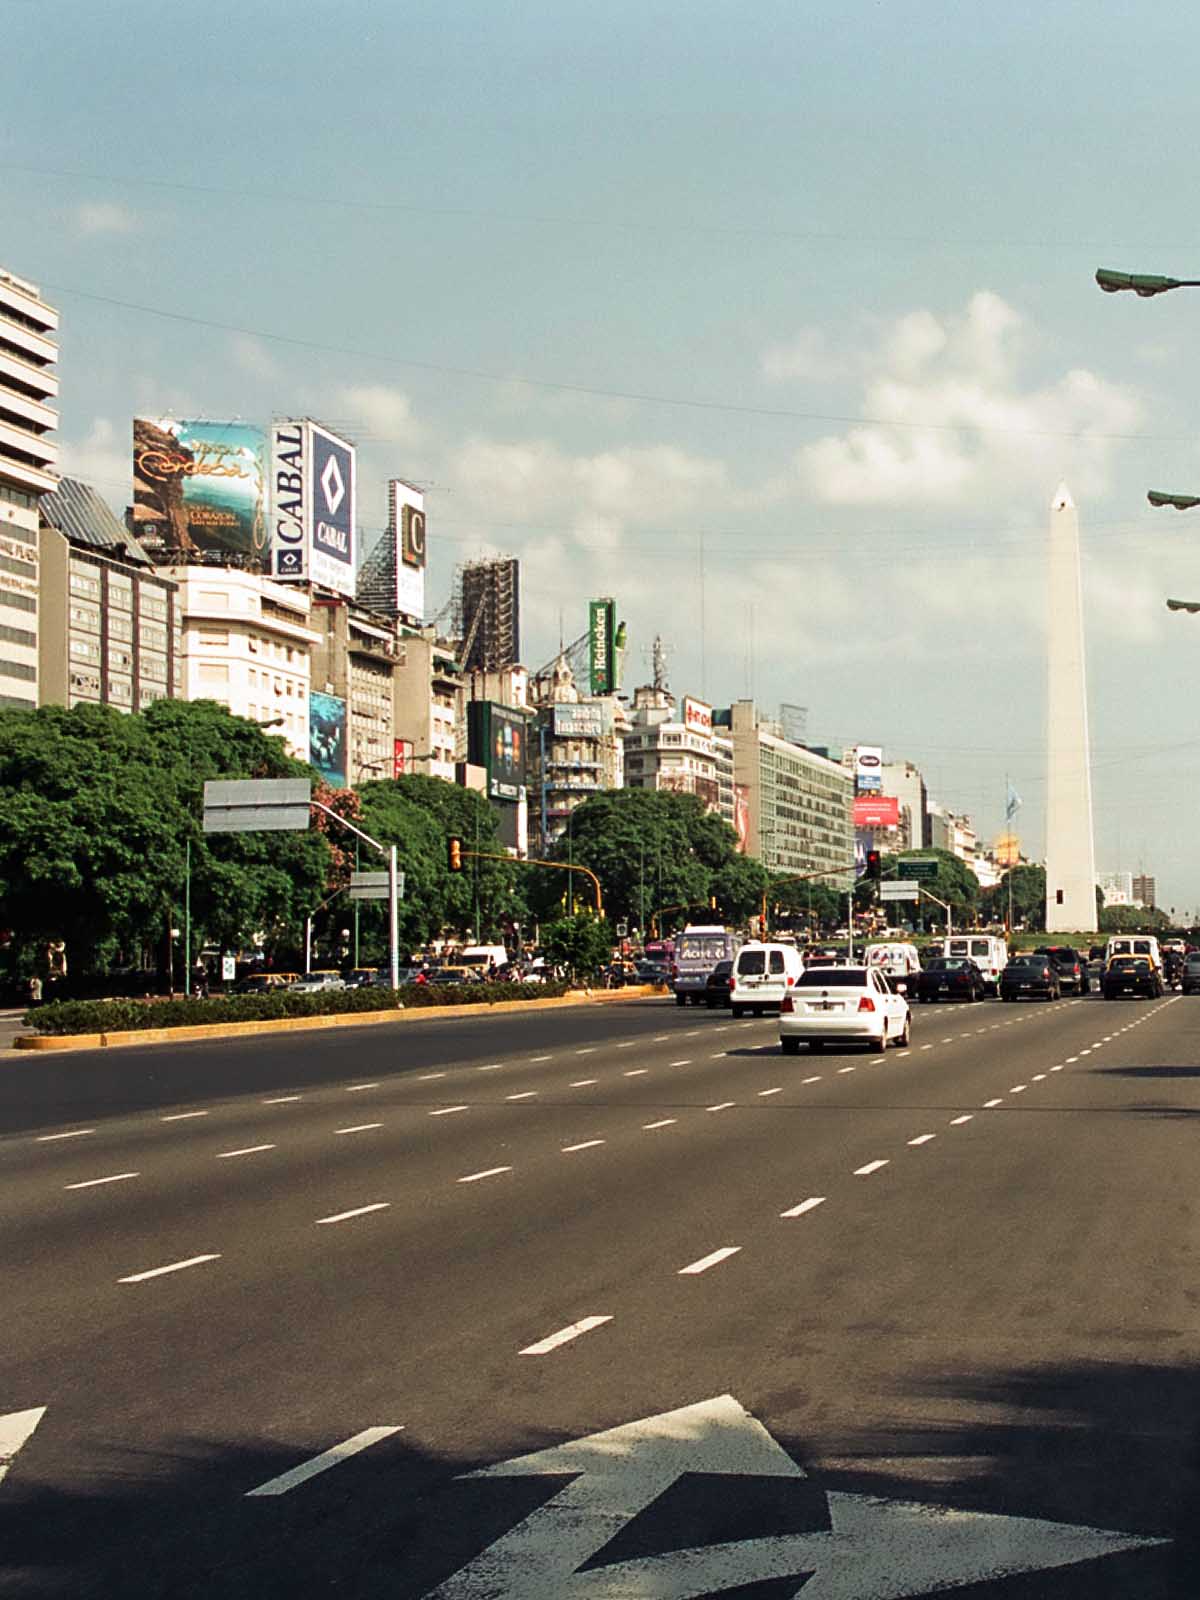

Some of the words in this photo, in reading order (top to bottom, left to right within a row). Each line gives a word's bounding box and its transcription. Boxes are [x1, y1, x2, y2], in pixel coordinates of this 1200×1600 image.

[277, 424, 303, 544] CABAL
[317, 521, 347, 553] CABAL
[594, 608, 606, 669] Heineken
